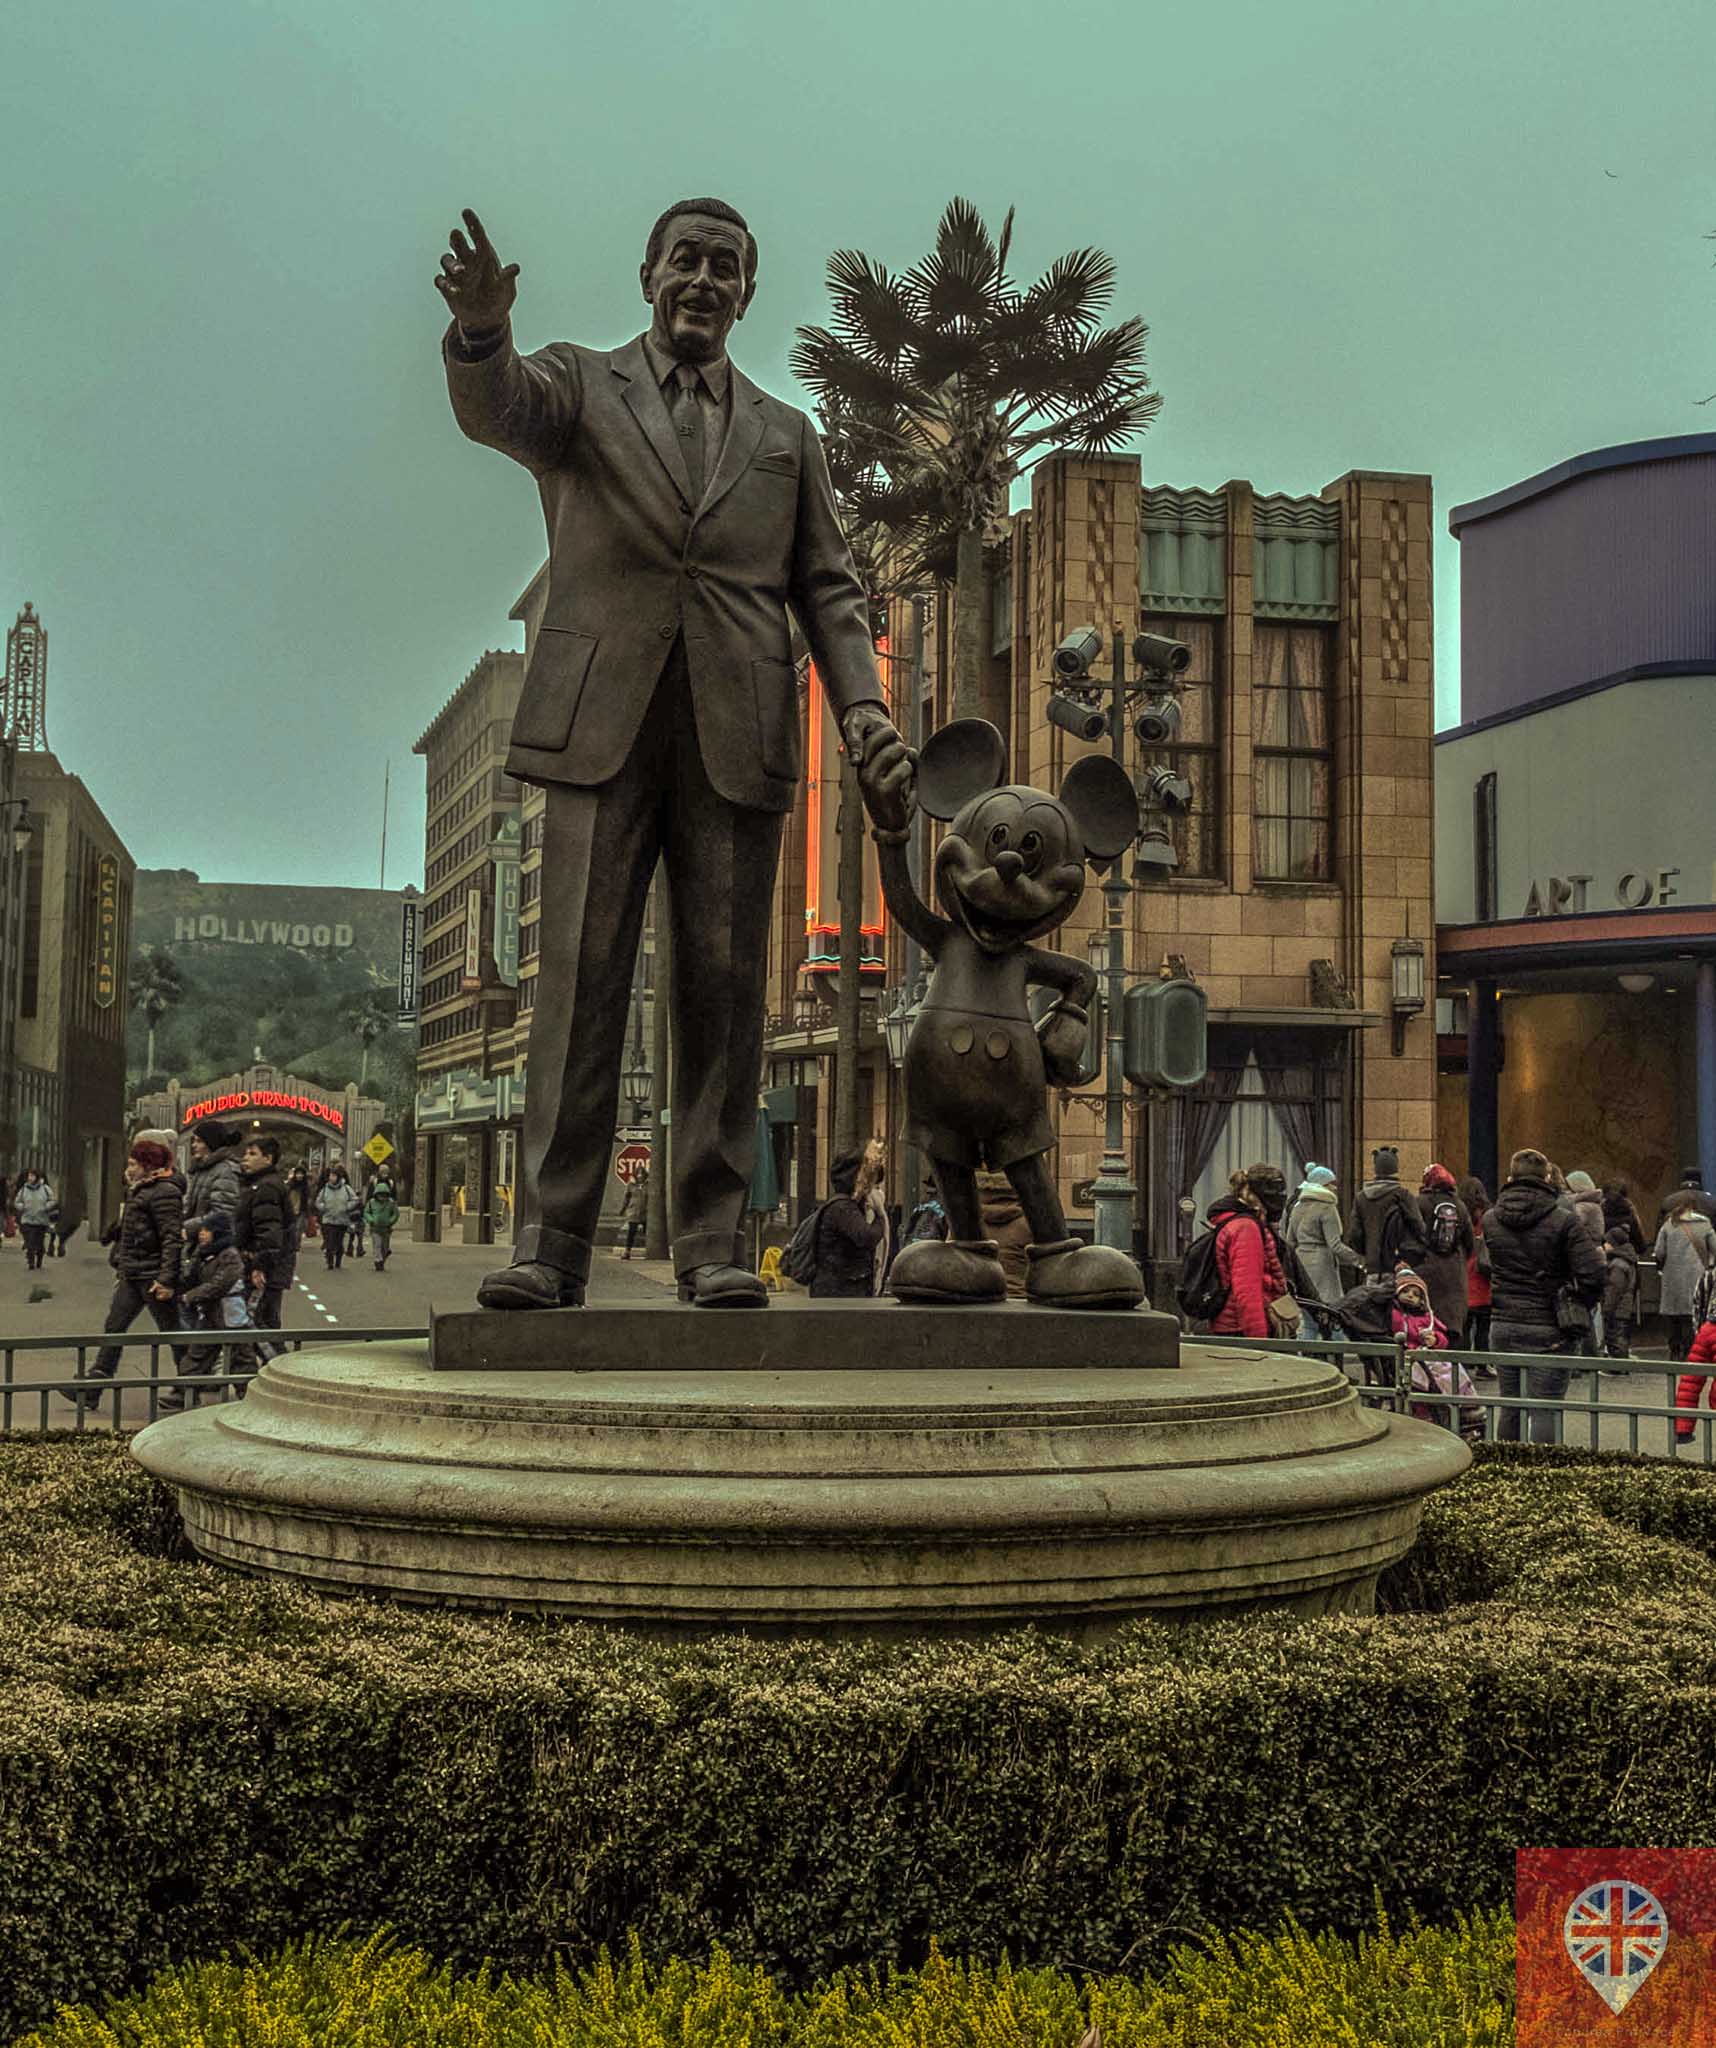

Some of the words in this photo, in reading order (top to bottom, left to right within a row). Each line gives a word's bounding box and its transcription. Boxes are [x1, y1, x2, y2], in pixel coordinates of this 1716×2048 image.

[16, 642, 33, 736] CAPITAN
[99, 880, 114, 992] CAPITAN
[175, 914, 353, 947] HOLLYWOOD
[503, 866, 517, 977] HOTEL
[1522, 874, 1593, 917] ART
[1615, 867, 1680, 909] OF
[403, 905, 413, 1010] LARCHMONT
[183, 1091, 250, 1124] STUDIO
[251, 1090, 297, 1109] TRAM
[299, 1096, 344, 1130] TOUR
